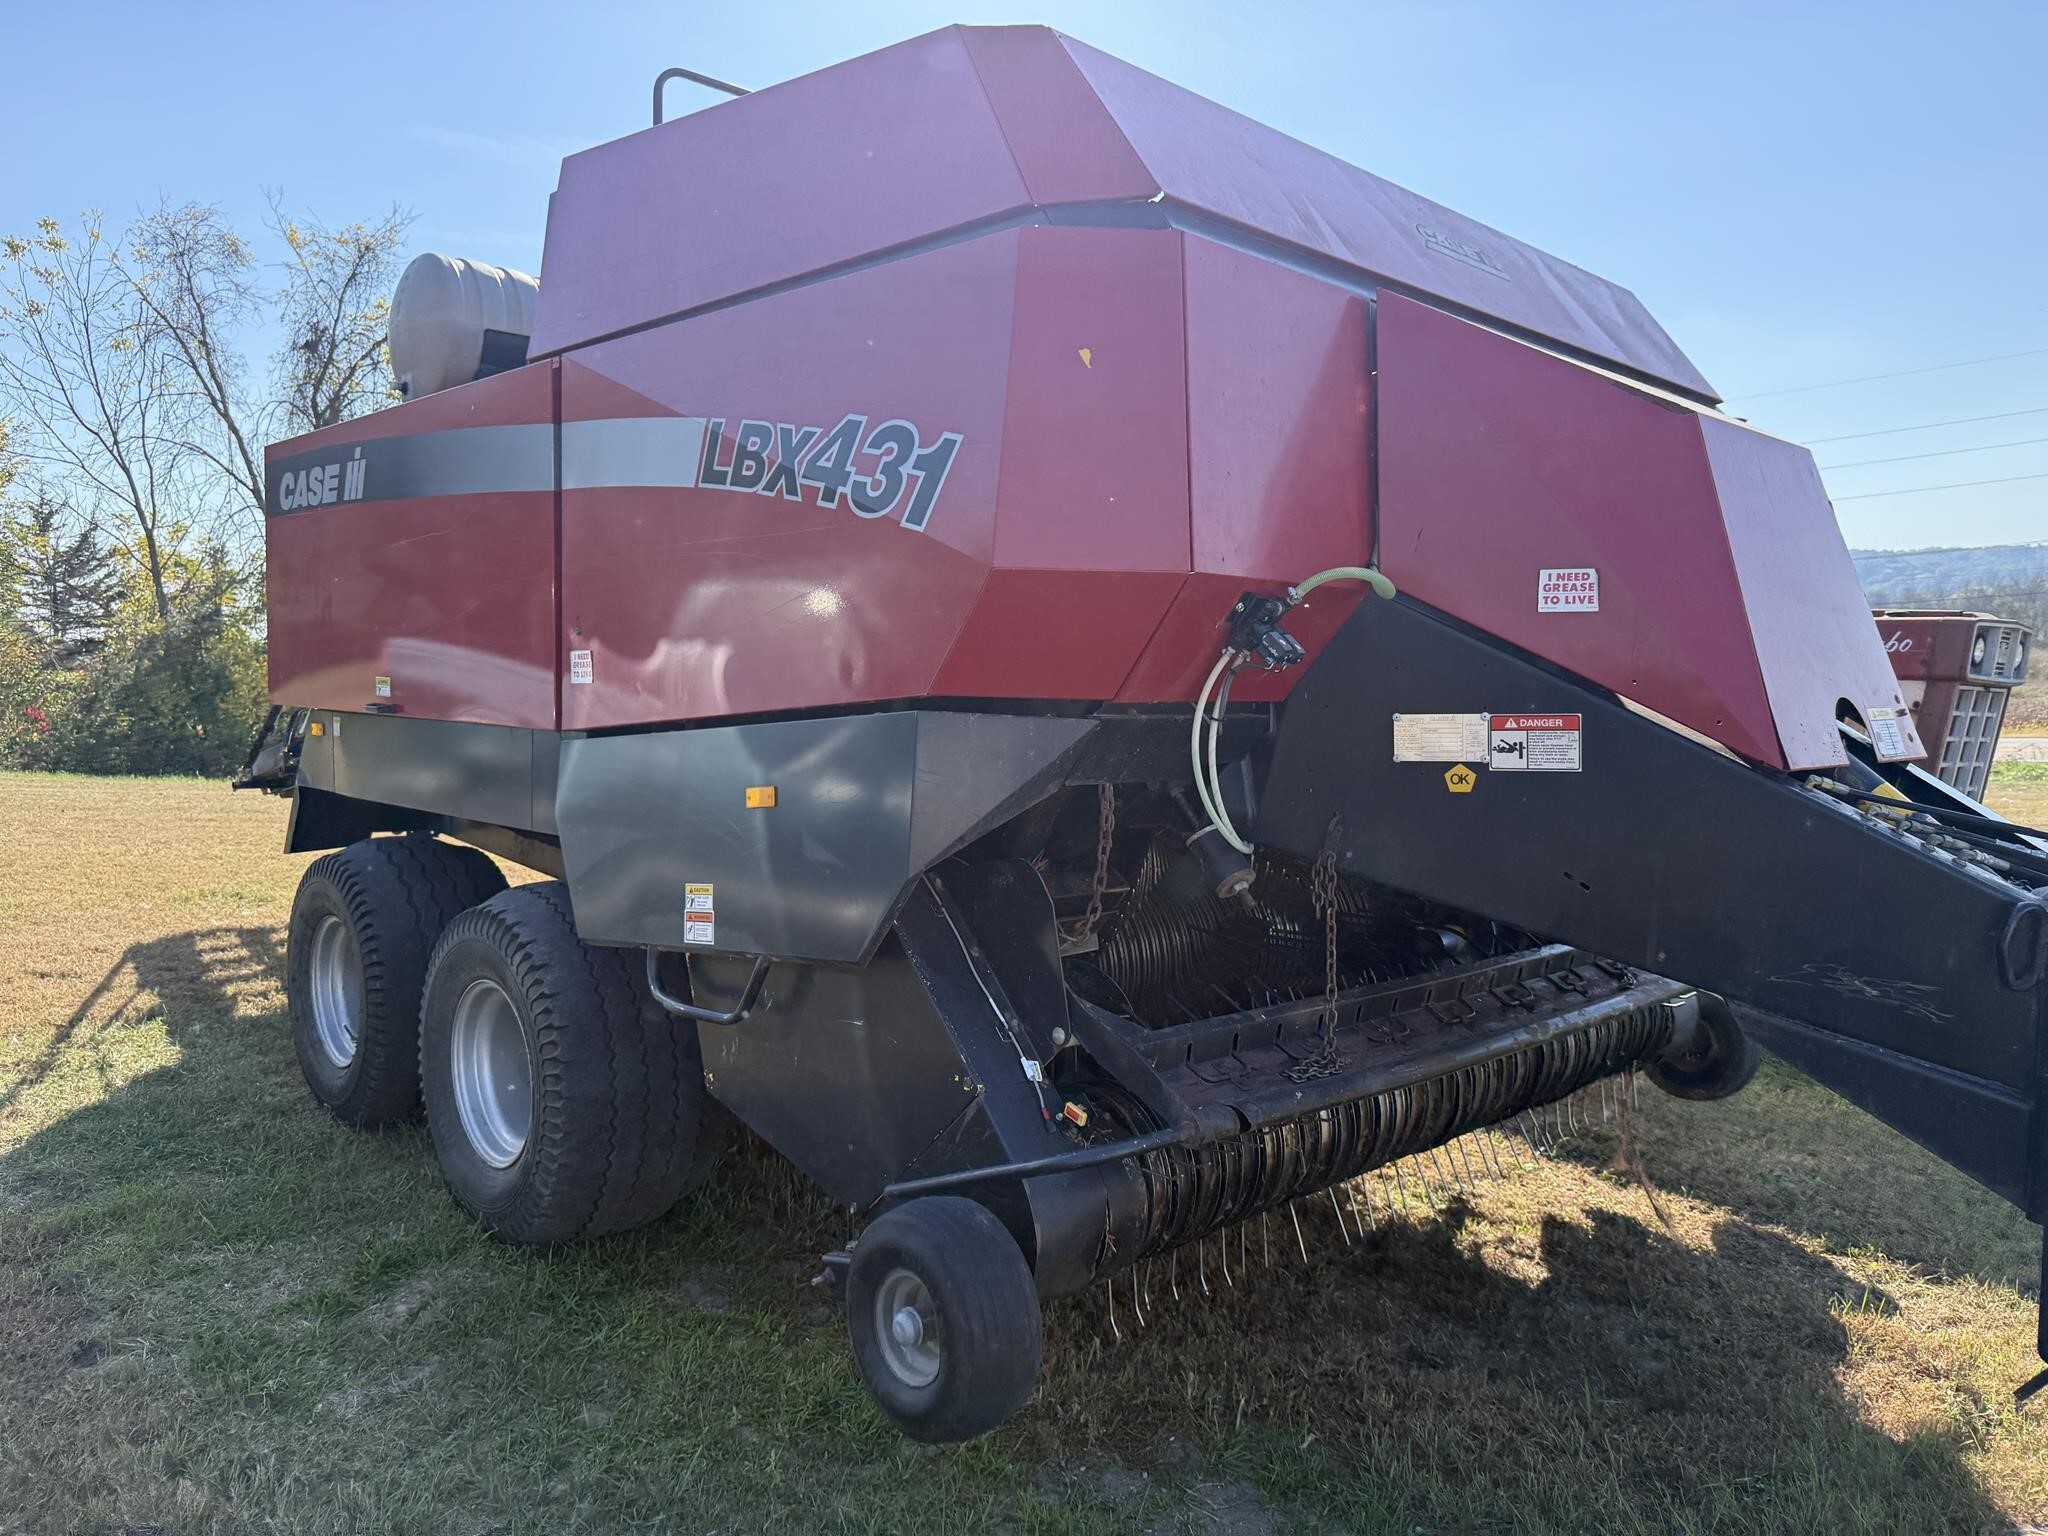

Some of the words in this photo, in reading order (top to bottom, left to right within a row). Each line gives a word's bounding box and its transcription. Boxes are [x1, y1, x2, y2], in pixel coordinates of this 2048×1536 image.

[698, 413, 964, 532] LBX431
[280, 463, 340, 511] CASE
[1547, 573, 1552, 582] I
[1556, 572, 1590, 582] NEED
[1542, 582, 1595, 593] GREASE
[1542, 595, 1560, 605] TO
[1564, 594, 1595, 605] LIVE
[572, 661, 592, 669] GREASE
[573, 670, 580, 679] TO
[1519, 719, 1563, 727] DANGER
[1450, 773, 1470, 785] OK
